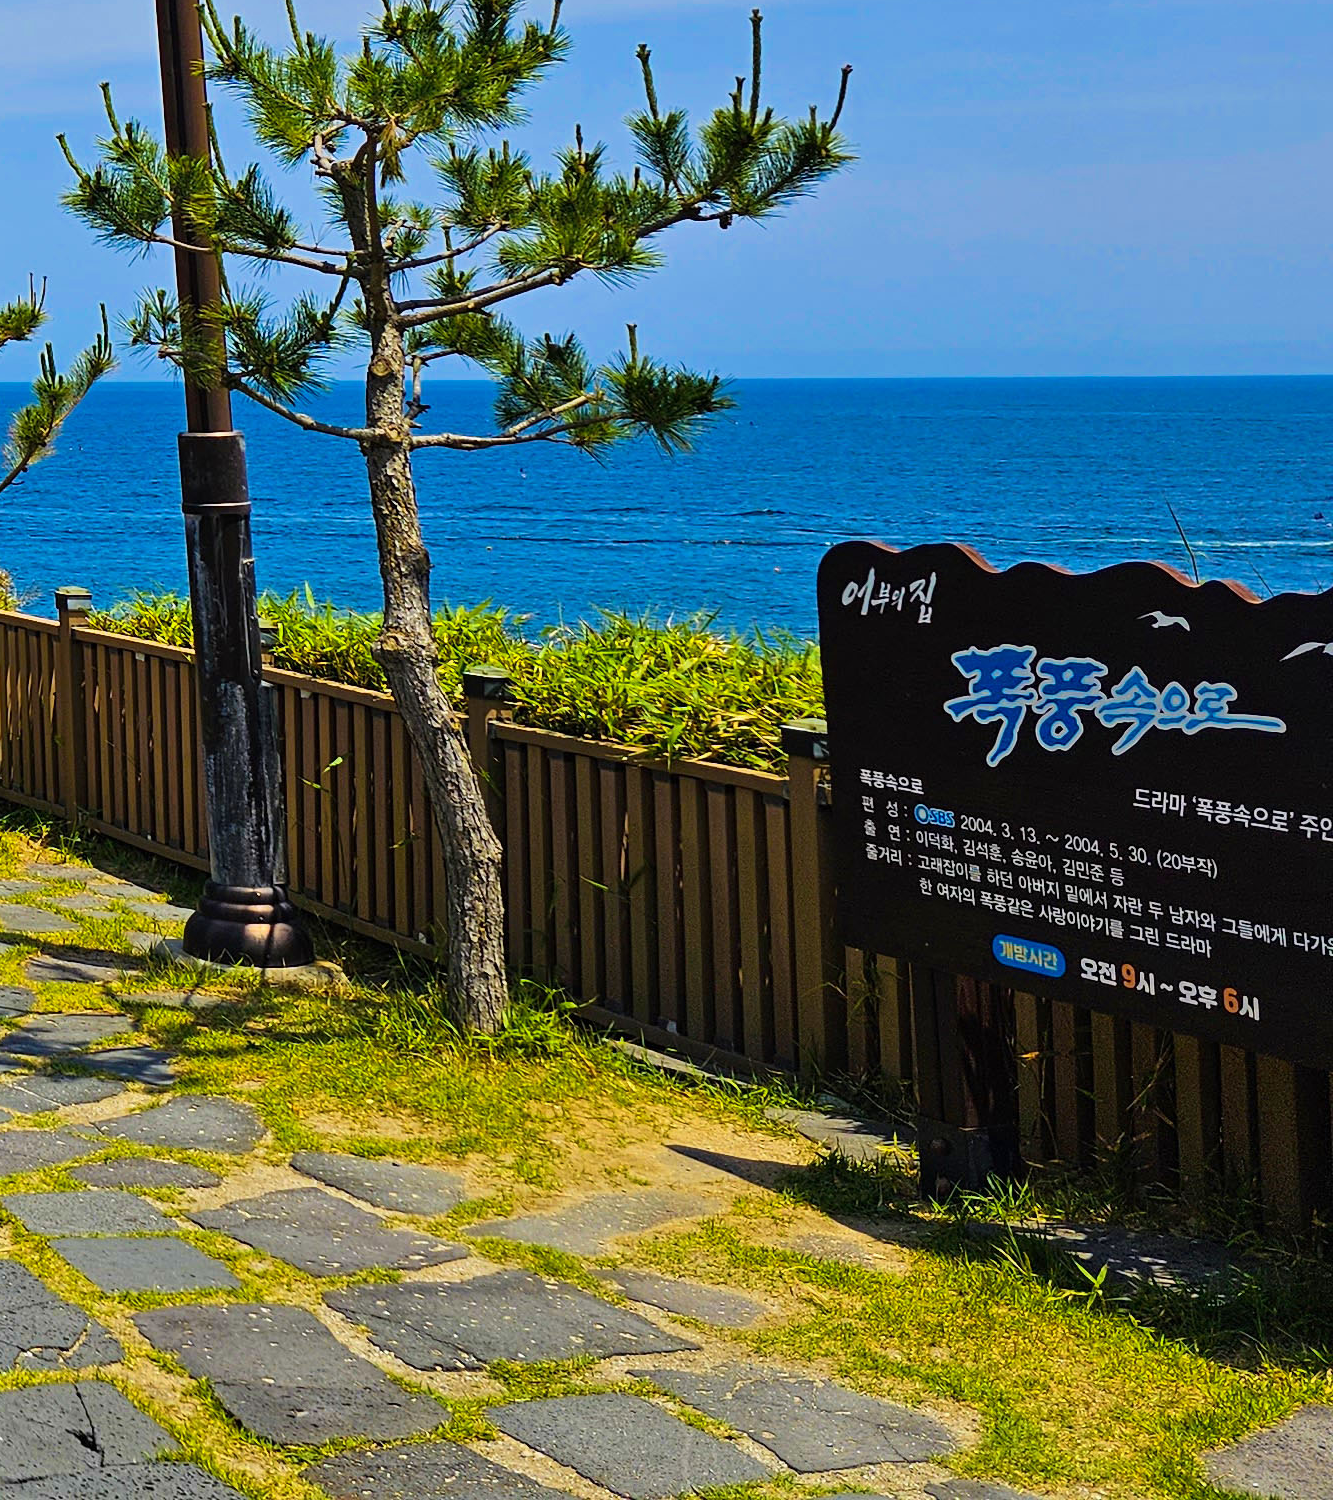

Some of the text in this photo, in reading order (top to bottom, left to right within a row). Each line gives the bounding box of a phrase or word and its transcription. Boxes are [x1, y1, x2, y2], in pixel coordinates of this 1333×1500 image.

[943, 643, 1287, 768] 폭풍속으로
[859, 768, 925, 795] 폭풍속으로
[1132, 788, 1187, 818] 드라마
[1192, 795, 1295, 833] ‘폭풍속으로’
[915, 830, 958, 854] 이덕화,
[962, 838, 1007, 864] 김석훈,
[1010, 847, 1057, 874] 송윤아,
[1061, 858, 1105, 883] 김민준
[1109, 867, 1125, 887] 등
[960, 814, 997, 837] 2004.
[1001, 822, 1015, 841] 3.
[1020, 826, 1041, 845] 13.
[1064, 834, 1104, 857] 2004.
[1109, 842, 1123, 861] 5.
[1128, 845, 1152, 866] 30.
[1156, 848, 1219, 880] (20부작)
[865, 842, 903, 867] 줄거리
[917, 853, 982, 882] 고래잡이를
[986, 868, 1014, 890] 하던
[1018, 874, 1060, 900] 아버지
[1064, 884, 1108, 910] 밑에서
[1112, 894, 1143, 917] 자란
[1147, 901, 1164, 920] 두
[1168, 905, 1217, 933] 남자와
[1221, 917, 1287, 948] 그들에게
[919, 877, 1213, 959] 한 여자의 폭풍같은 사랑이야기를 그린 드라마
[999, 940, 1058, 972] 개방시간
[1080, 957, 1118, 987] 오전
[1121, 963, 1156, 996] 9시
[1178, 980, 1218, 1010] 오후
[1222, 987, 1260, 1021] 6시
